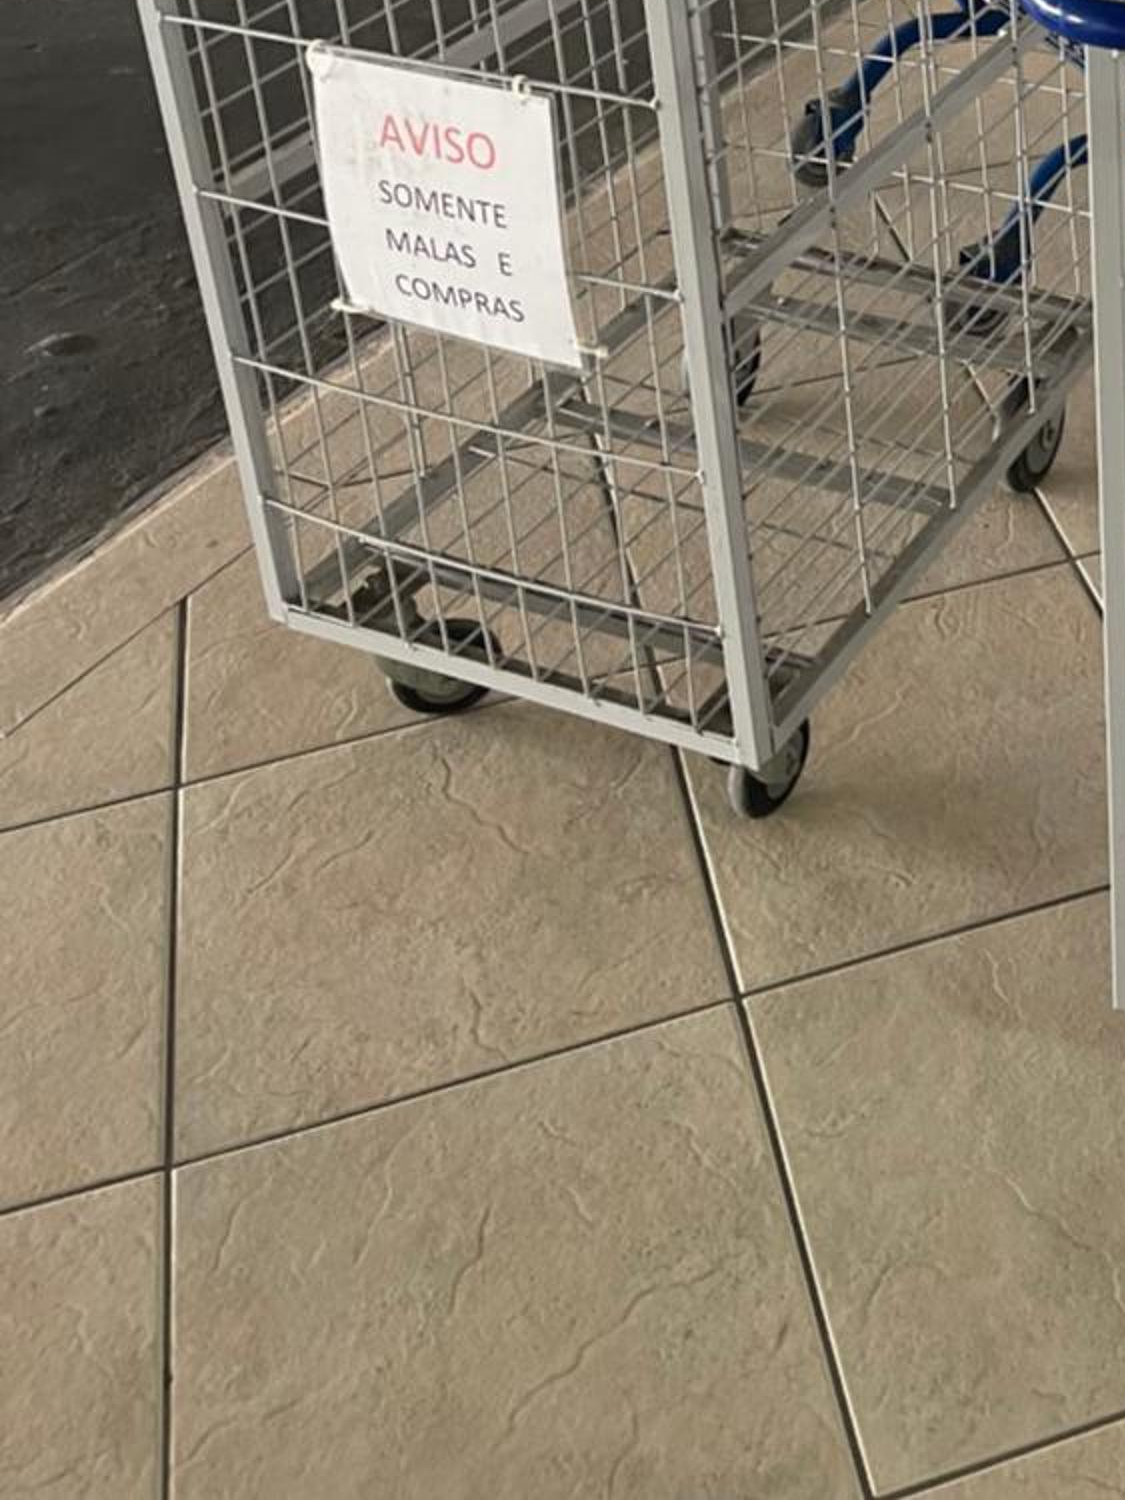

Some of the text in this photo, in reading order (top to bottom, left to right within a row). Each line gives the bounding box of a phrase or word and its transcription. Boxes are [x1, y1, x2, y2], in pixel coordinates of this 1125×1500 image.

[379, 114, 497, 170] AVISO
[378, 179, 507, 229] SOMENTE
[385, 228, 513, 277] MALAS E
[395, 273, 525, 323] COMPRAS
